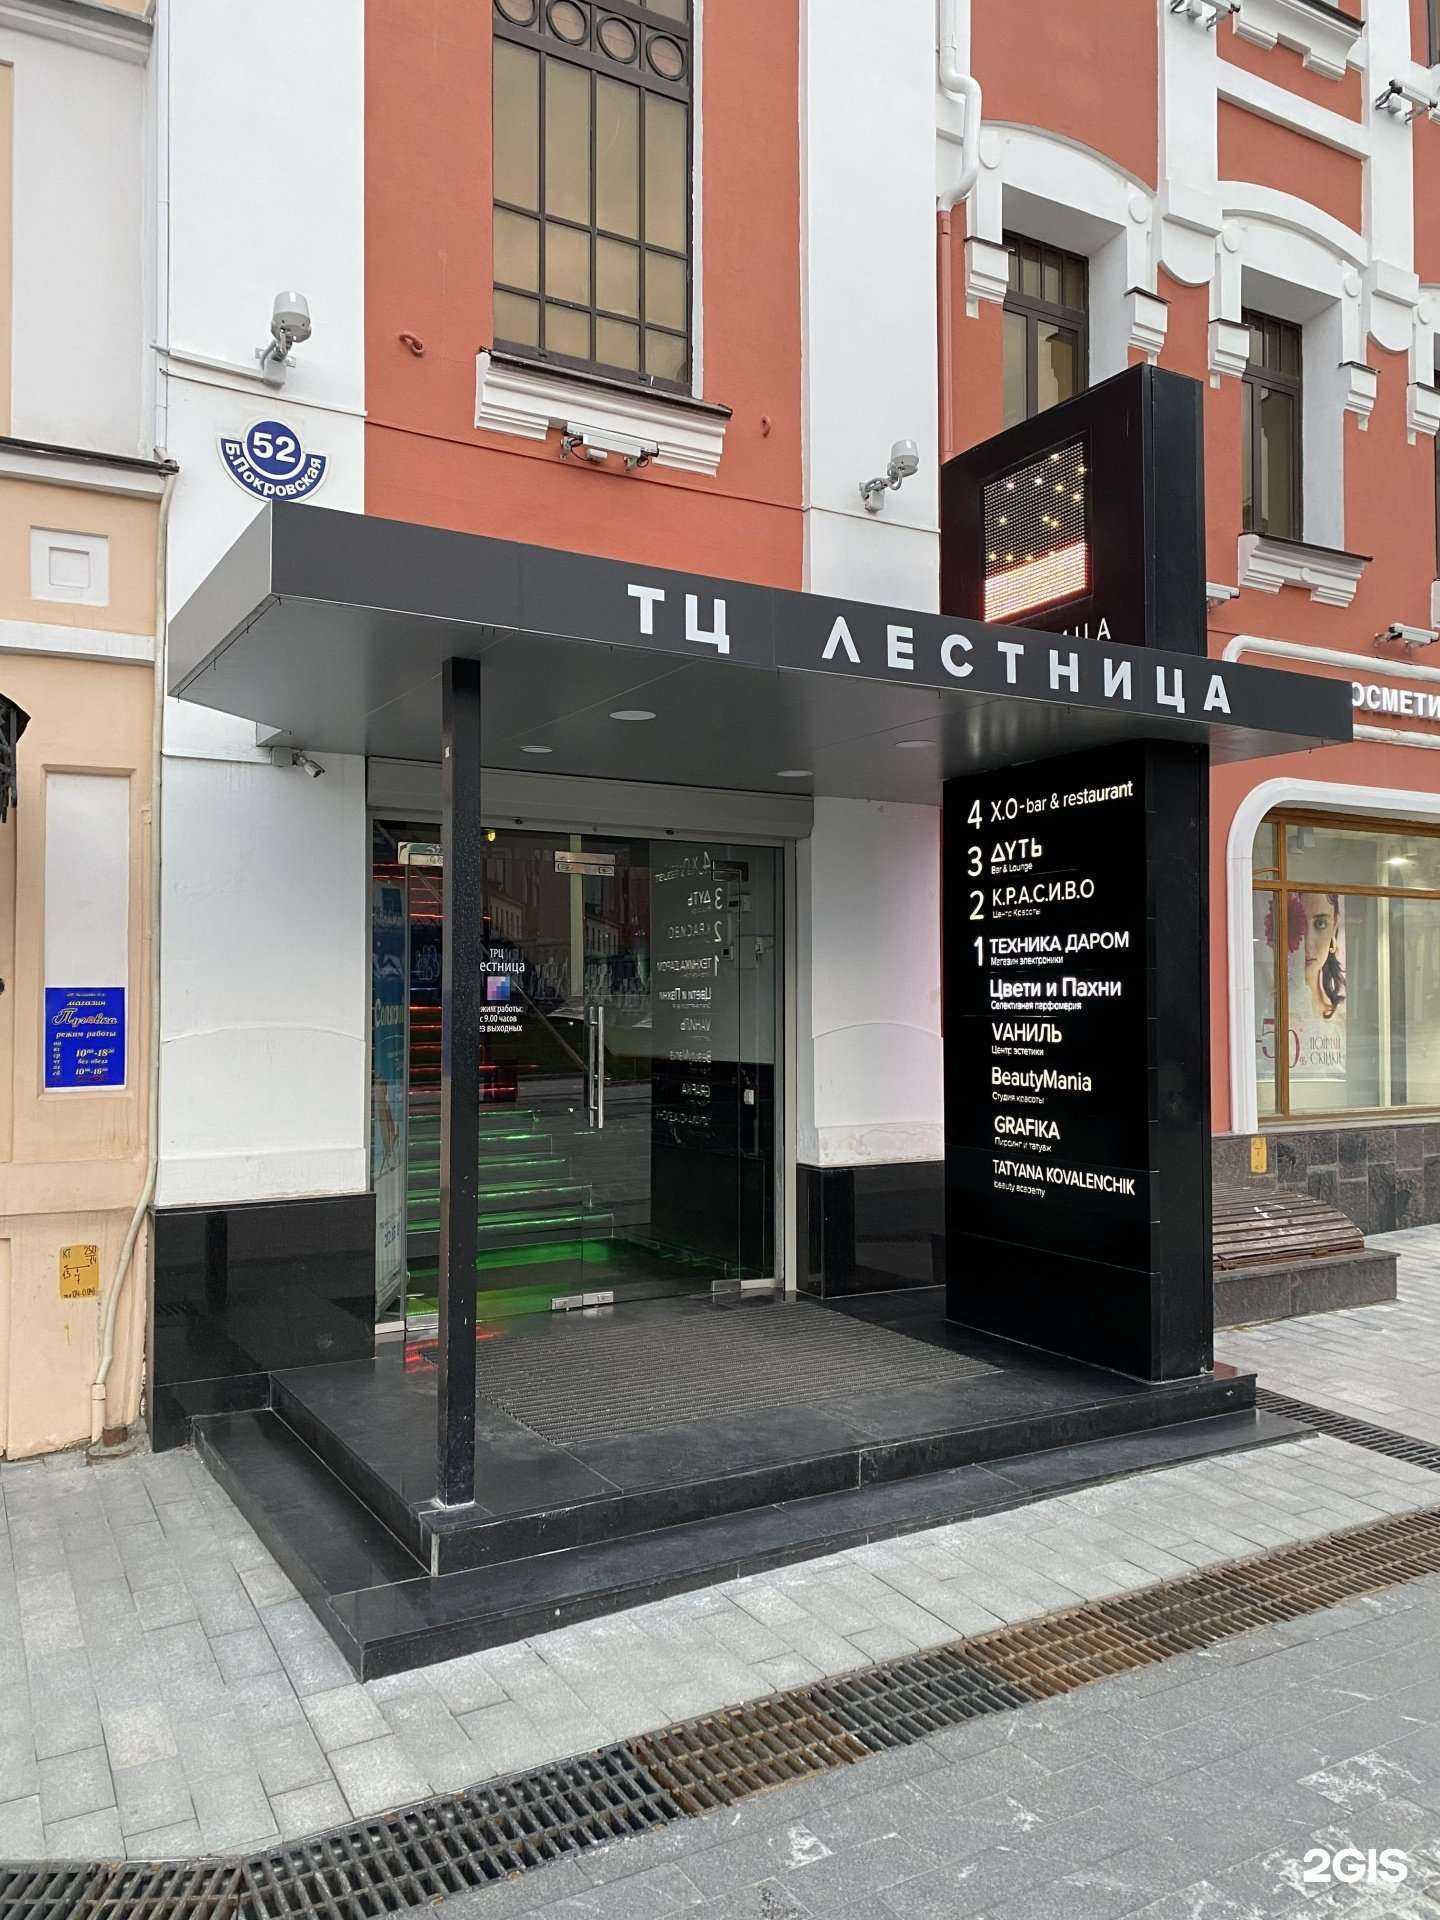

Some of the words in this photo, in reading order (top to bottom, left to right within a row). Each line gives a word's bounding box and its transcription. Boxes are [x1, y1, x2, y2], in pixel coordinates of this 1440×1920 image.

[252, 431, 296, 463] 52
[225, 442, 322, 497] Б.Покровская
[627, 583, 731, 655] ТЦ
[967, 799, 983, 830] 4
[1050, 793, 1060, 809] &
[1063, 780, 1134, 807] restaurant
[967, 845, 983, 877] 3
[991, 865, 1002, 875] Bar
[1009, 862, 1033, 873] Lounge
[969, 890, 985, 921] 2
[489, 948, 504, 959] ТРЦ
[973, 936, 983, 967] 1
[989, 935, 1061, 954] ТЕХНИКА
[1064, 931, 1129, 954] ДАРОМ
[990, 956, 1019, 966] Магазин
[1019, 955, 1064, 966] электроники
[989, 978, 1041, 1000] Цвети
[1046, 982, 1057, 997] и
[1062, 976, 1122, 997] Пахни
[990, 1000, 1034, 1010] Селективная
[1034, 1001, 1082, 1012] парфюмерия
[484, 1014, 498, 1023] 9.00
[499, 1015, 518, 1023] часов
[487, 1024, 523, 1034] выходных
[991, 1045, 1012, 1056] Центр
[1013, 1047, 1044, 1056] эстетики
[991, 1066, 1092, 1092] BeautyMania
[992, 1091, 1016, 1102] Студия
[1016, 1095, 1045, 1104] красоты
[994, 1115, 1061, 1140] GRAFIKA
[992, 1159, 1044, 1181] TATYANA
[1046, 1166, 1136, 1196] KOVALENCHIK
[993, 1180, 1015, 1192] beauty
[1015, 1184, 1046, 1198] academy
